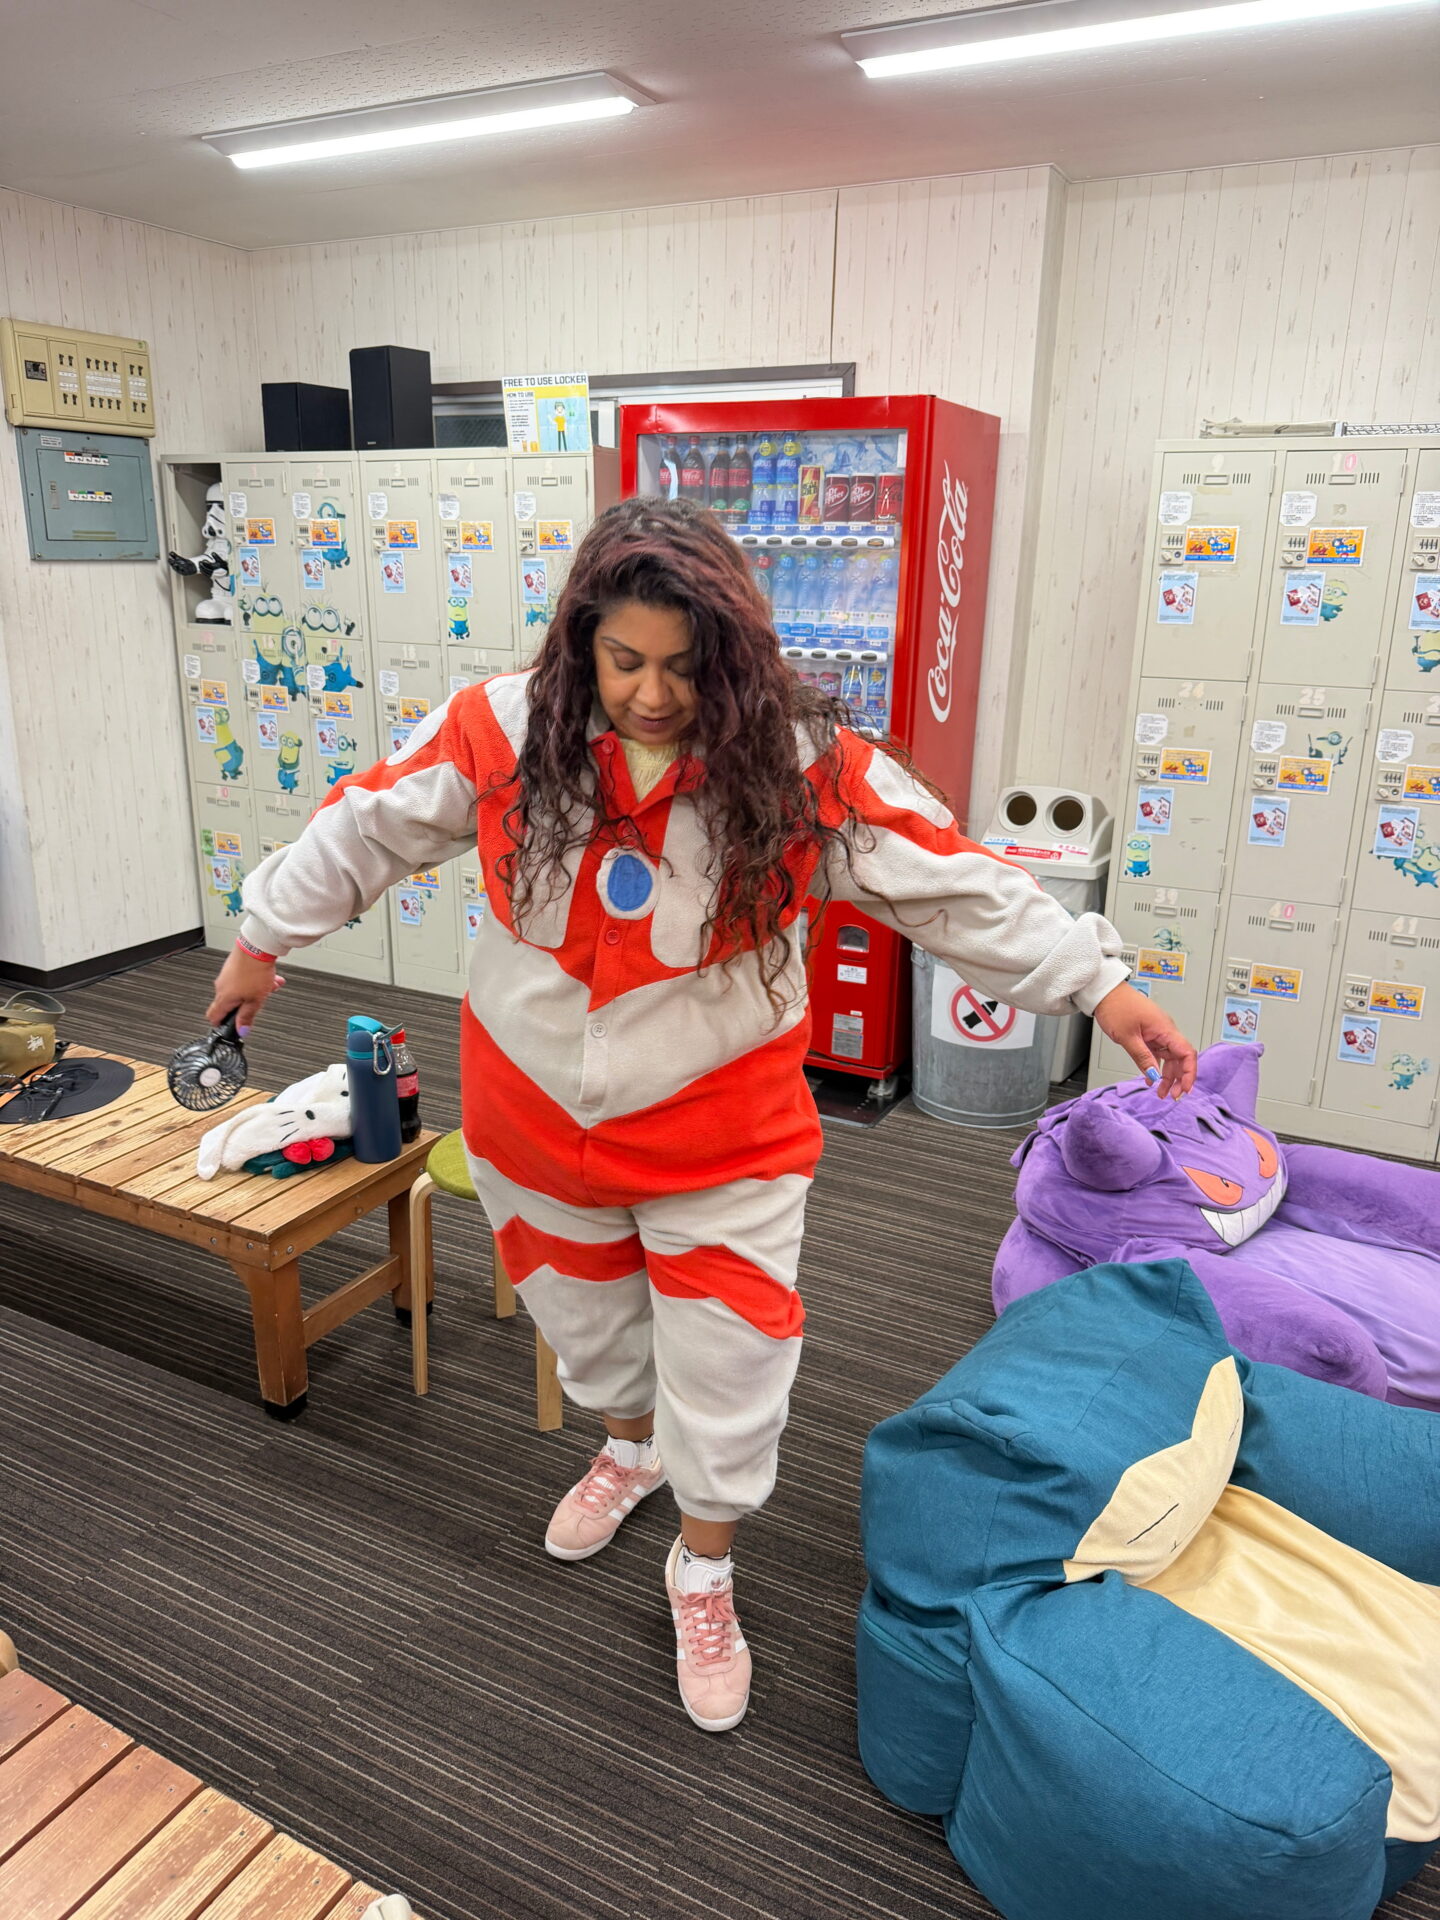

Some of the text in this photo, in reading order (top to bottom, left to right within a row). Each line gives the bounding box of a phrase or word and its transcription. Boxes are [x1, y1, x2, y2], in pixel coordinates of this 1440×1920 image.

[503, 375, 587, 387] FREE TO USE LOCKER
[394, 462, 402, 477] 3
[1211, 453, 1224, 473] 9
[1331, 452, 1357, 473] 10
[928, 460, 968, 723] Coca-Cola
[1177, 681, 1204, 699] 24
[1298, 687, 1326, 706] 25
[1154, 887, 1178, 906] 39
[1266, 901, 1295, 920] 40
[1390, 915, 1417, 935] 41
